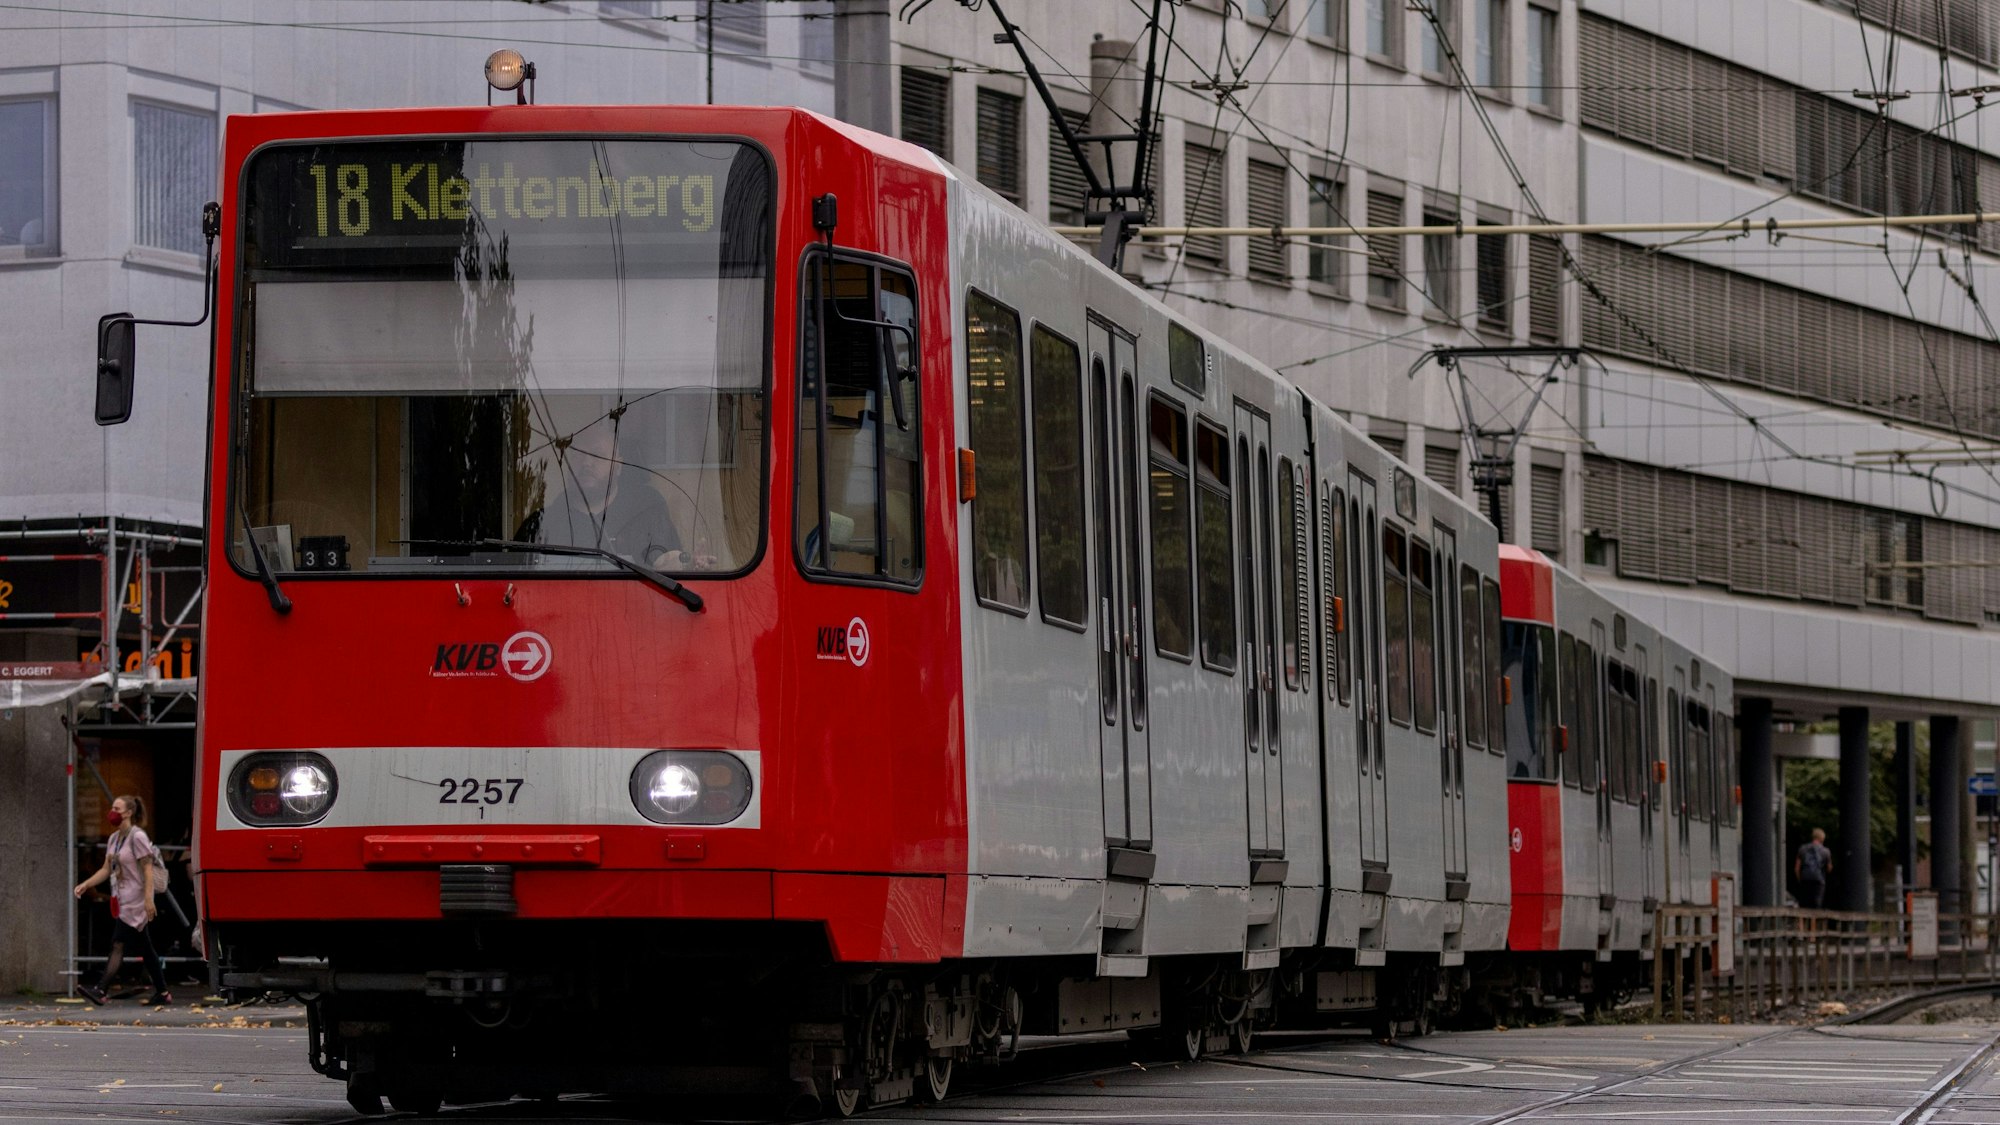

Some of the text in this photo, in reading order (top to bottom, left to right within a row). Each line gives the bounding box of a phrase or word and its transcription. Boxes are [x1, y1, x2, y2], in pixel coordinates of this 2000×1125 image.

[310, 159, 714, 237] 18 Klettenberg
[817, 626, 846, 654] KVB
[433, 643, 500, 671] KVB
[13, 666, 53, 676] EGGERT
[439, 778, 524, 805] 2257
[479, 806, 484, 819] 1
